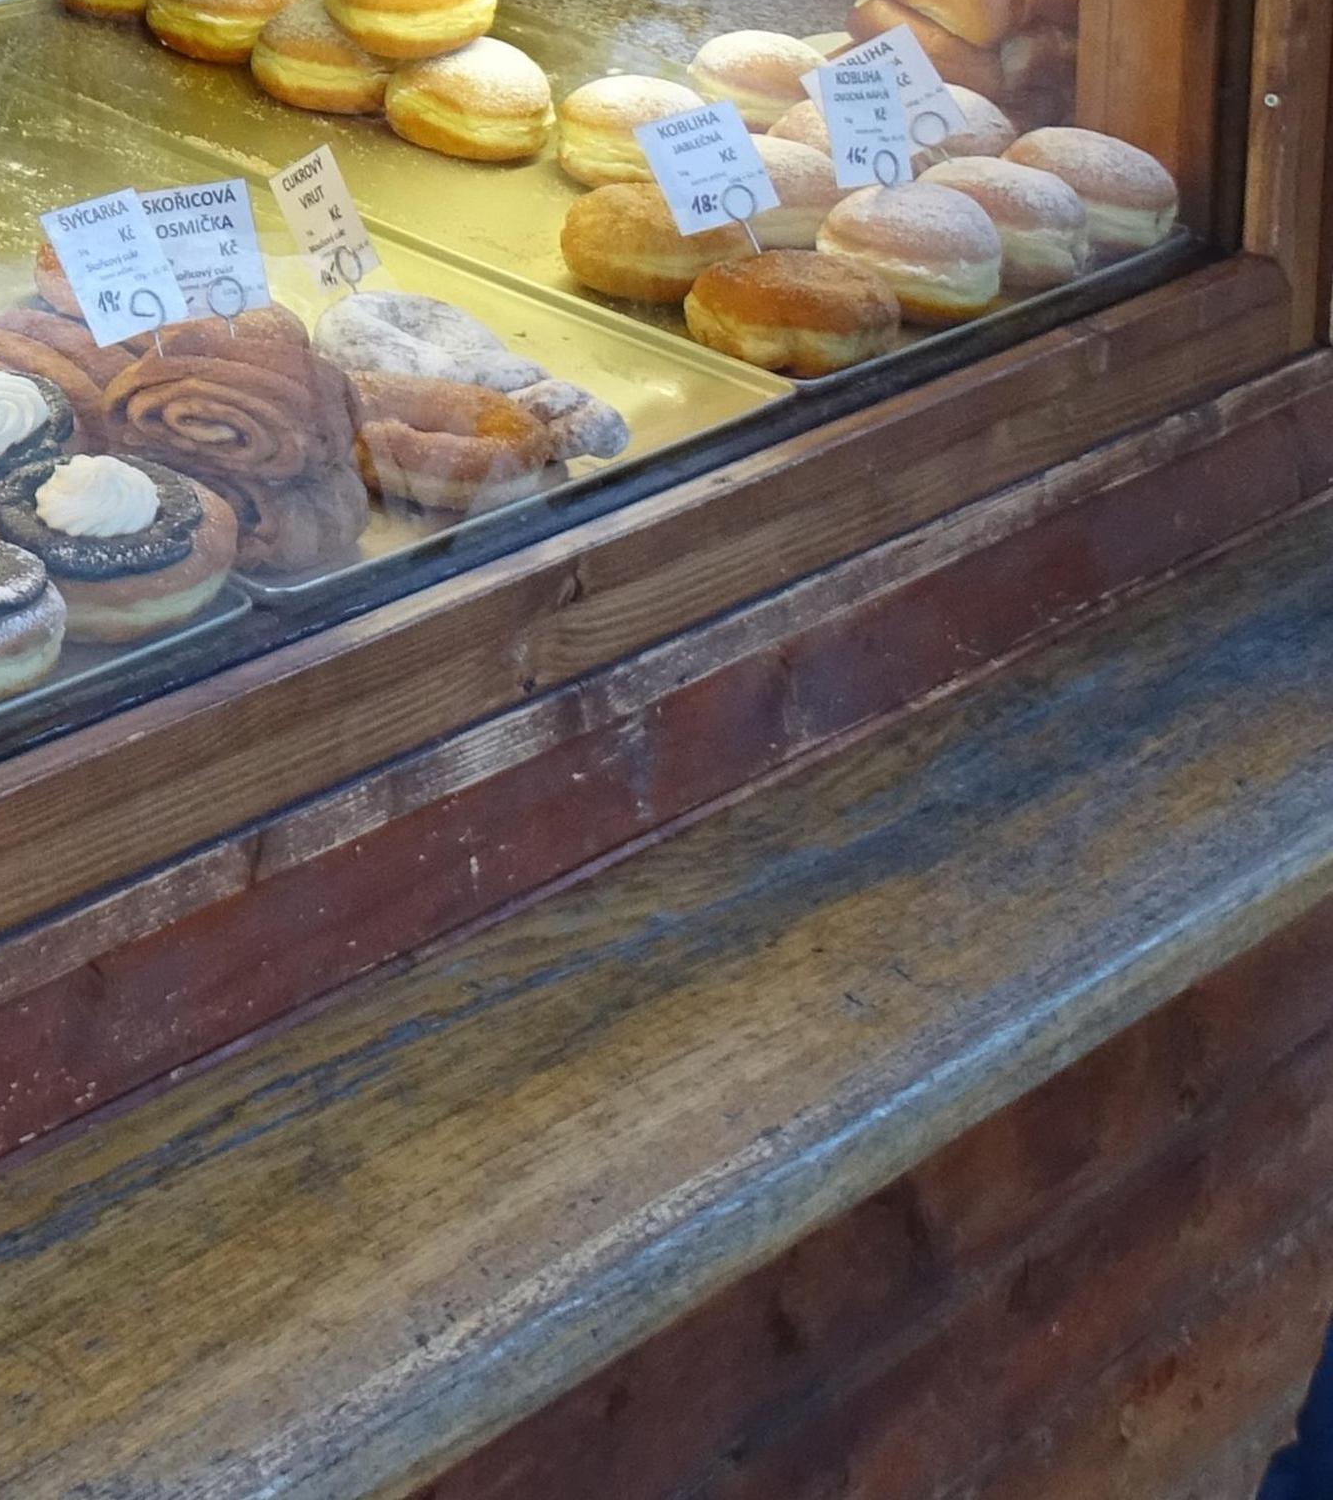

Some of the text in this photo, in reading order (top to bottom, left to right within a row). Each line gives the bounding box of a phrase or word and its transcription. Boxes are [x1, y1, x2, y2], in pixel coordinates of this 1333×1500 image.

[835, 70, 882, 85] KOBLIHA
[656, 111, 721, 140] KOBLIHA
[873, 106, 887, 121] Kč
[672, 130, 723, 156] JABLEČNÁ
[718, 146, 738, 163] Kč
[281, 153, 323, 192] CUKROVÝ
[142, 184, 236, 215] SKOŘICOVÁ
[298, 185, 324, 209] VRUT
[58, 200, 129, 232] ŠVÝCARKA
[155, 214, 234, 239] OSMIČKA
[118, 224, 136, 242] Kč
[219, 239, 238, 256] Kč
